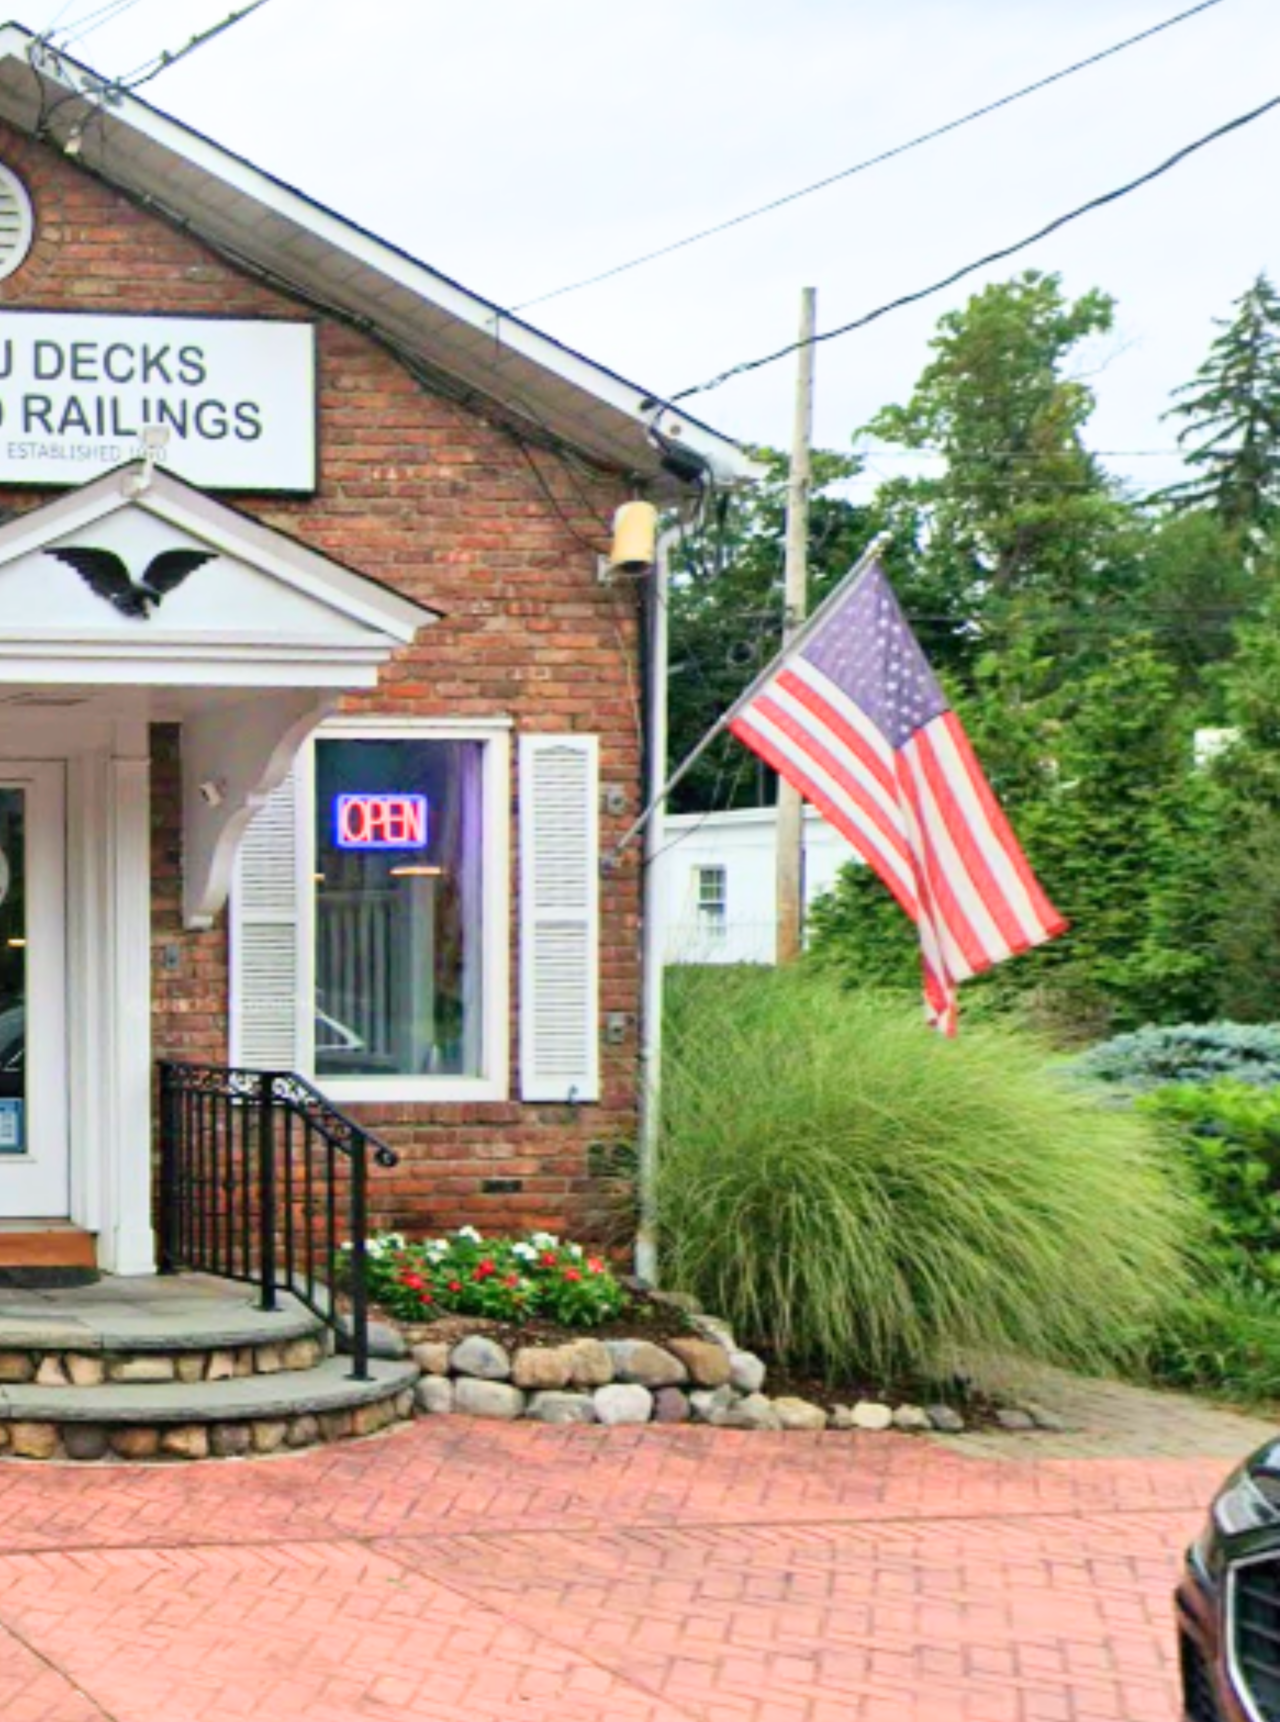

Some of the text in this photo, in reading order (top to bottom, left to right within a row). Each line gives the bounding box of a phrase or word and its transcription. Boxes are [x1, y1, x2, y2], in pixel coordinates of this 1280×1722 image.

[32, 339, 207, 386] DECKS
[22, 392, 262, 441] RAILINGS
[6, 440, 121, 462] ESTABLISHED
[341, 799, 424, 842] OPEN
